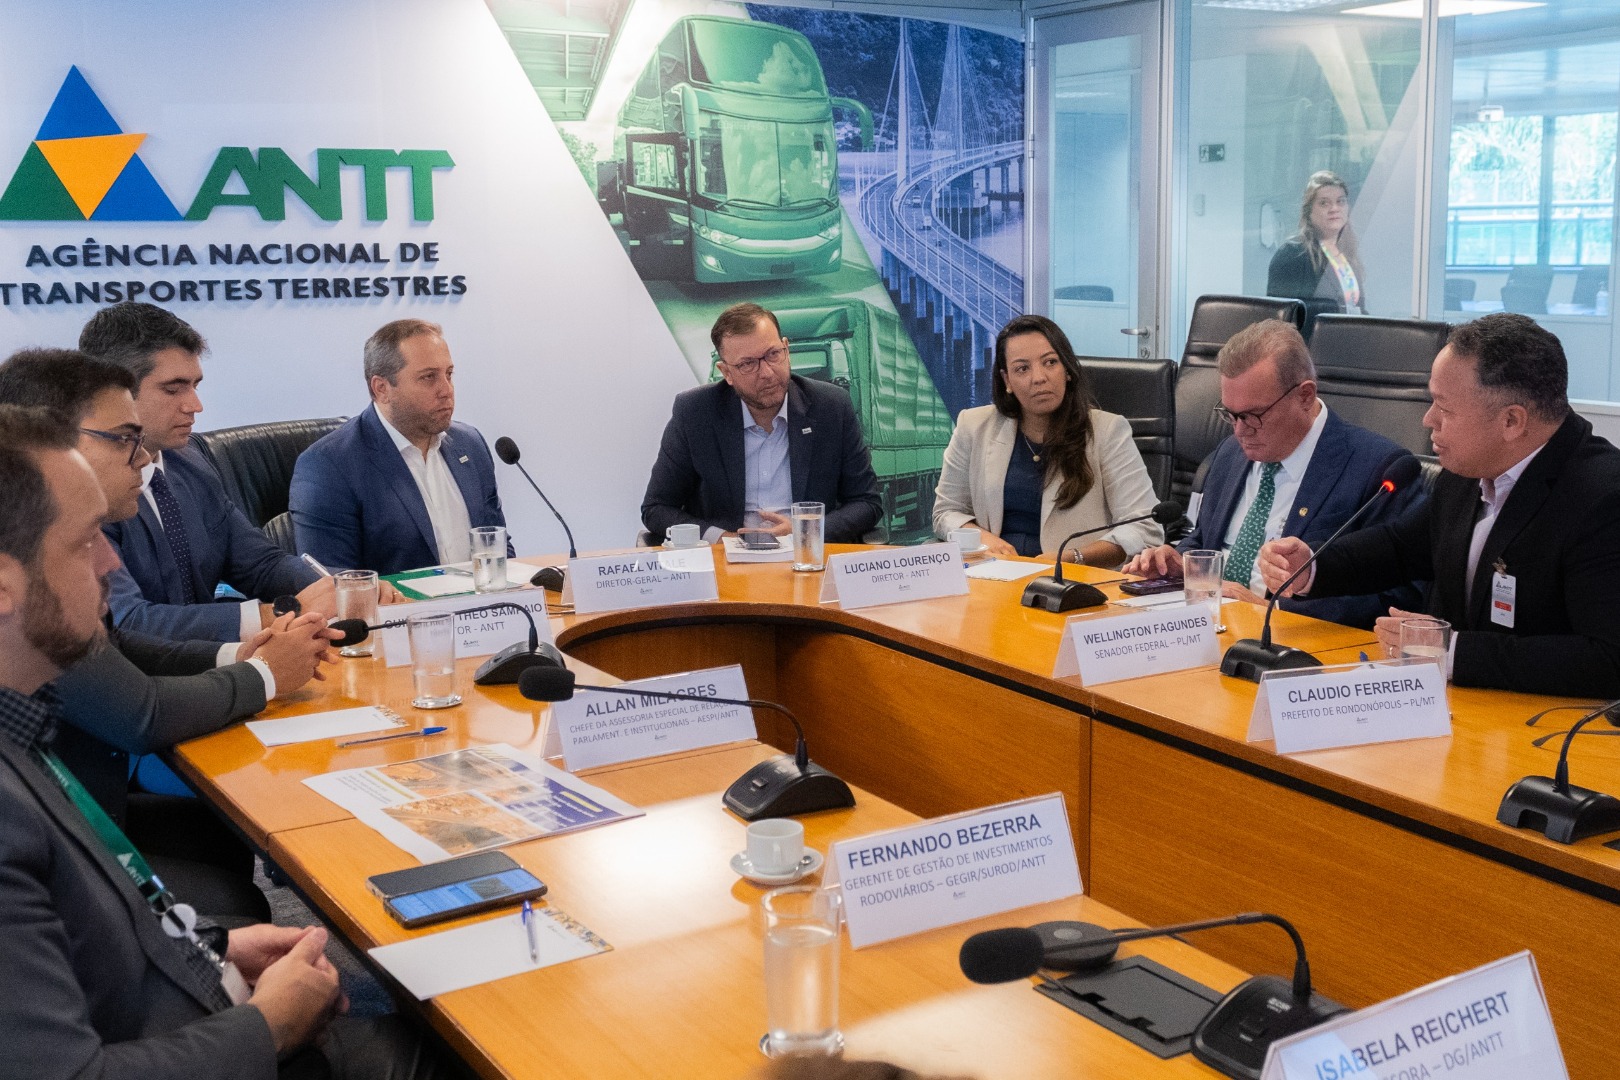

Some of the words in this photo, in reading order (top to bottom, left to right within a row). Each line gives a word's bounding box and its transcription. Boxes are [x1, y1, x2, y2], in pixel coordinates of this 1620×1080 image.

[184, 146, 456, 221] ANTT
[25, 237, 198, 267] AGÊNCIA
[208, 243, 390, 265] NACIONAL
[399, 242, 439, 263] DE
[0, 278, 263, 306] TRANSPORTES
[268, 275, 467, 300] TERRESTRES
[598, 562, 644, 576] RAFAEL
[844, 560, 891, 574] LUCIANO
[893, 552, 950, 568] LOURENÇO
[871, 572, 904, 583] DIRETOR
[911, 568, 930, 578] ANTT
[596, 574, 662, 589] DIRETOR-GERAL
[670, 571, 691, 581] ANTT
[458, 607, 488, 620] THEO
[480, 621, 504, 632] ANTT
[1084, 625, 1152, 645] WELLINGTON
[1154, 616, 1208, 635] FAGUNDES
[1094, 645, 1134, 660] SENADOR
[1135, 639, 1169, 653] FEDERAL
[1177, 633, 1201, 646] PL/MT
[1288, 685, 1351, 703] CLAUDIO
[1355, 678, 1424, 697] FERREIRA
[569, 722, 594, 733] CHEFE
[596, 720, 607, 729] DA
[609, 712, 653, 727] ASSESSORIA
[655, 706, 688, 719] ESPECIAL
[689, 704, 699, 713] DE
[586, 697, 636, 717] ALLAN
[1281, 709, 1320, 721] PREFEITO
[1323, 706, 1334, 716] DE
[1336, 700, 1402, 715] RONDONÓPOLIS
[1410, 696, 1435, 708] PL/MT
[624, 729, 630, 737] E
[630, 718, 689, 735] INSTITUCIONAIS
[697, 709, 738, 723] AESPI/ANTT
[848, 832, 952, 870] FERNANDO
[956, 813, 1042, 846] BEZERRA
[844, 870, 894, 891] GERENTE
[896, 867, 911, 880] DE
[913, 856, 955, 875] GESTÃO
[956, 853, 971, 866] DE
[972, 835, 1053, 862] INVESTIMENTOS
[860, 880, 935, 907] RODOVIÁRIOS
[945, 854, 1047, 887] GEGIR/SUROD/ANTT
[1315, 1032, 1411, 1080] ISABELA
[1411, 991, 1510, 1048] REICHERT
[1442, 1031, 1504, 1072] DG/ANTT
